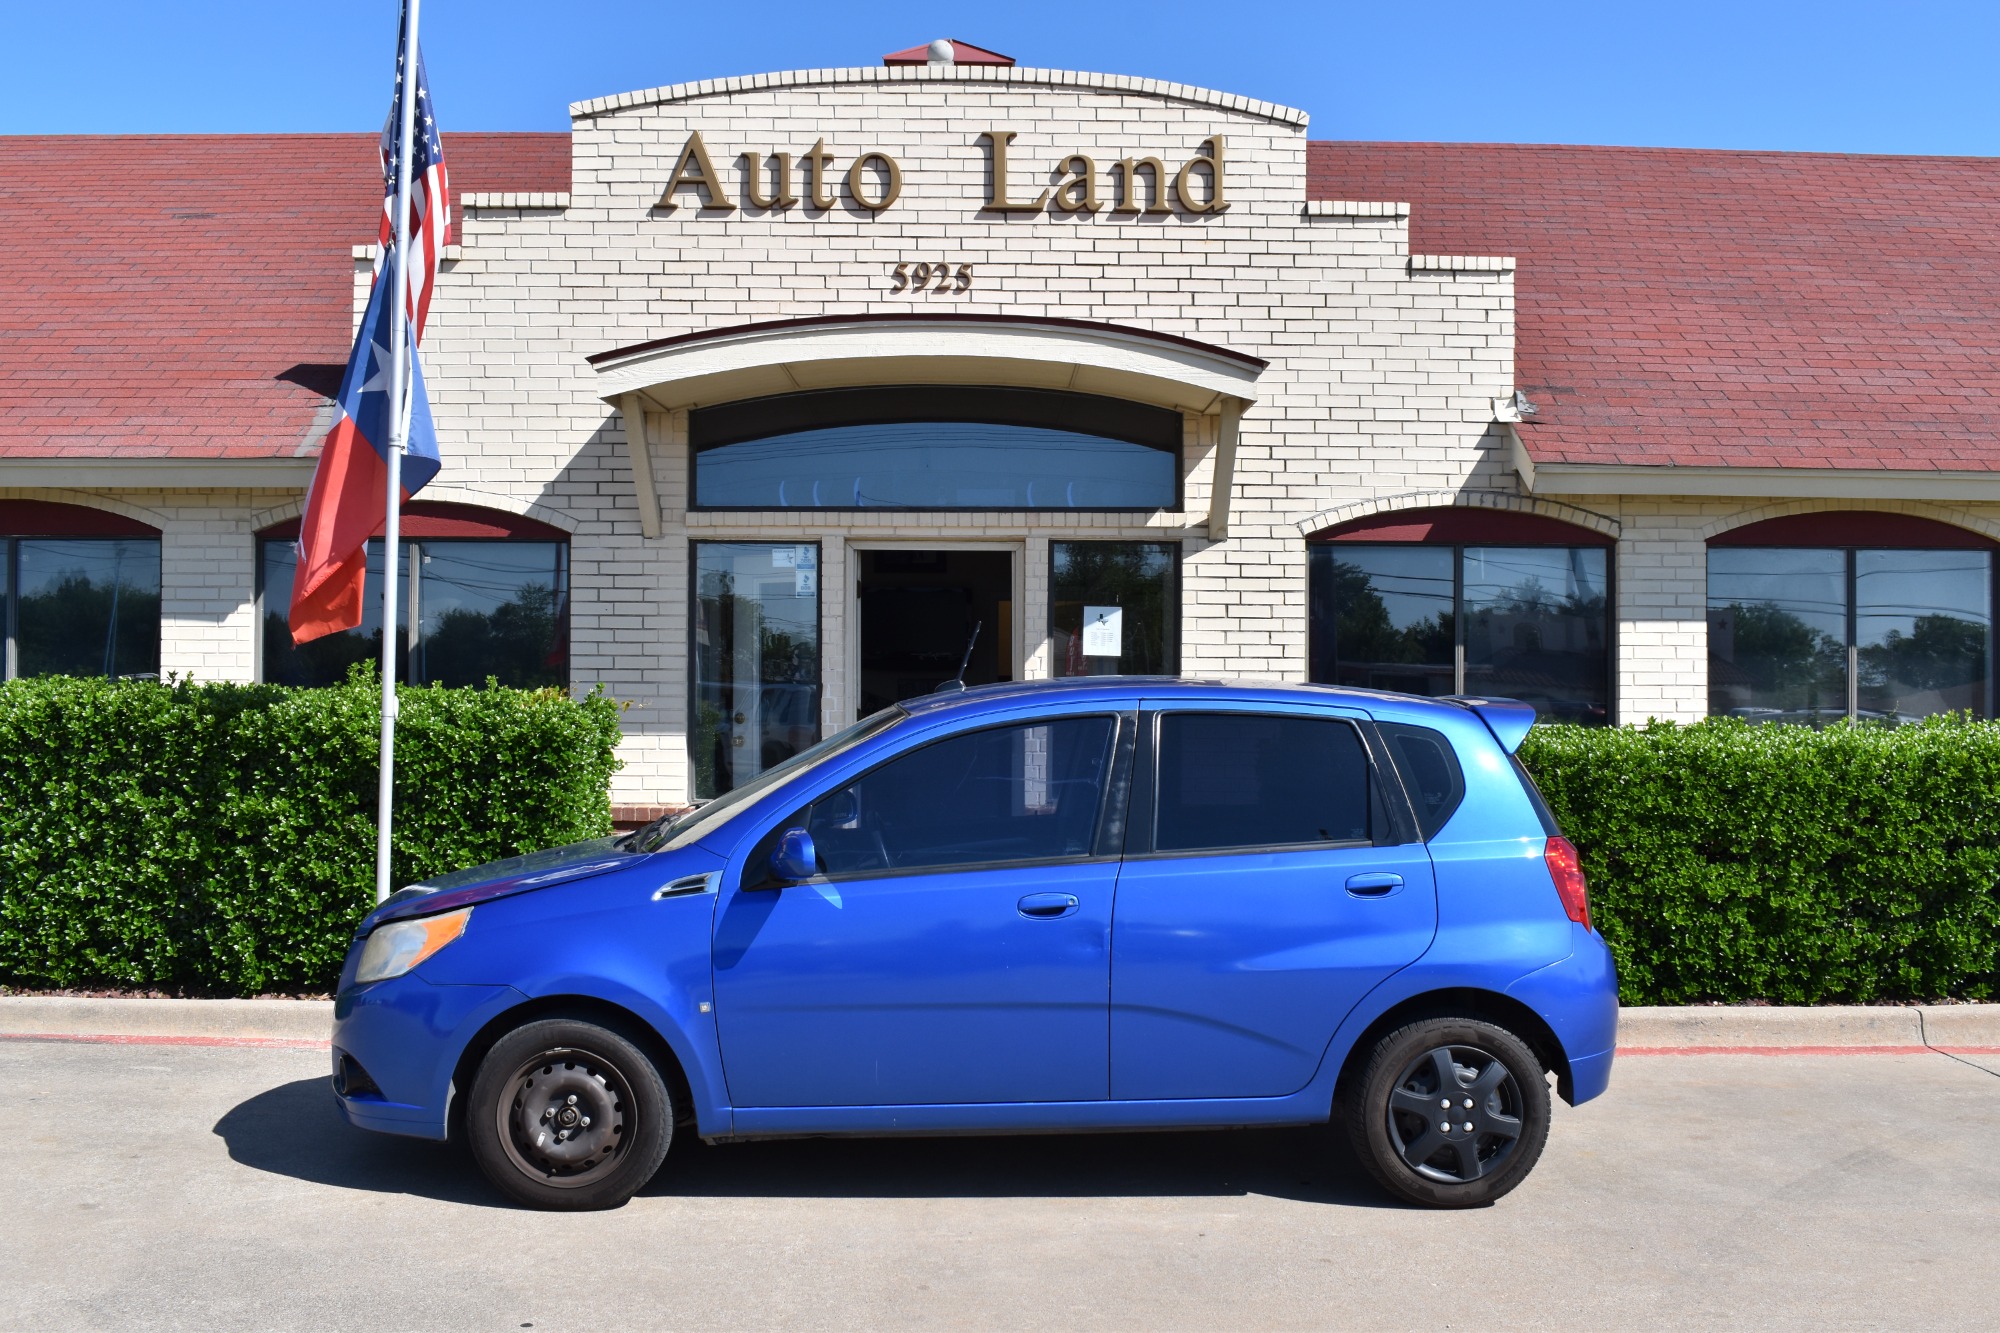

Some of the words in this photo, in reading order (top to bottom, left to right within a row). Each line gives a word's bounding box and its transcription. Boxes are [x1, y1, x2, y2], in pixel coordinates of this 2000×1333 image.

[652, 129, 903, 211] Auto
[981, 131, 1231, 214] Land
[892, 261, 973, 292] 5925
